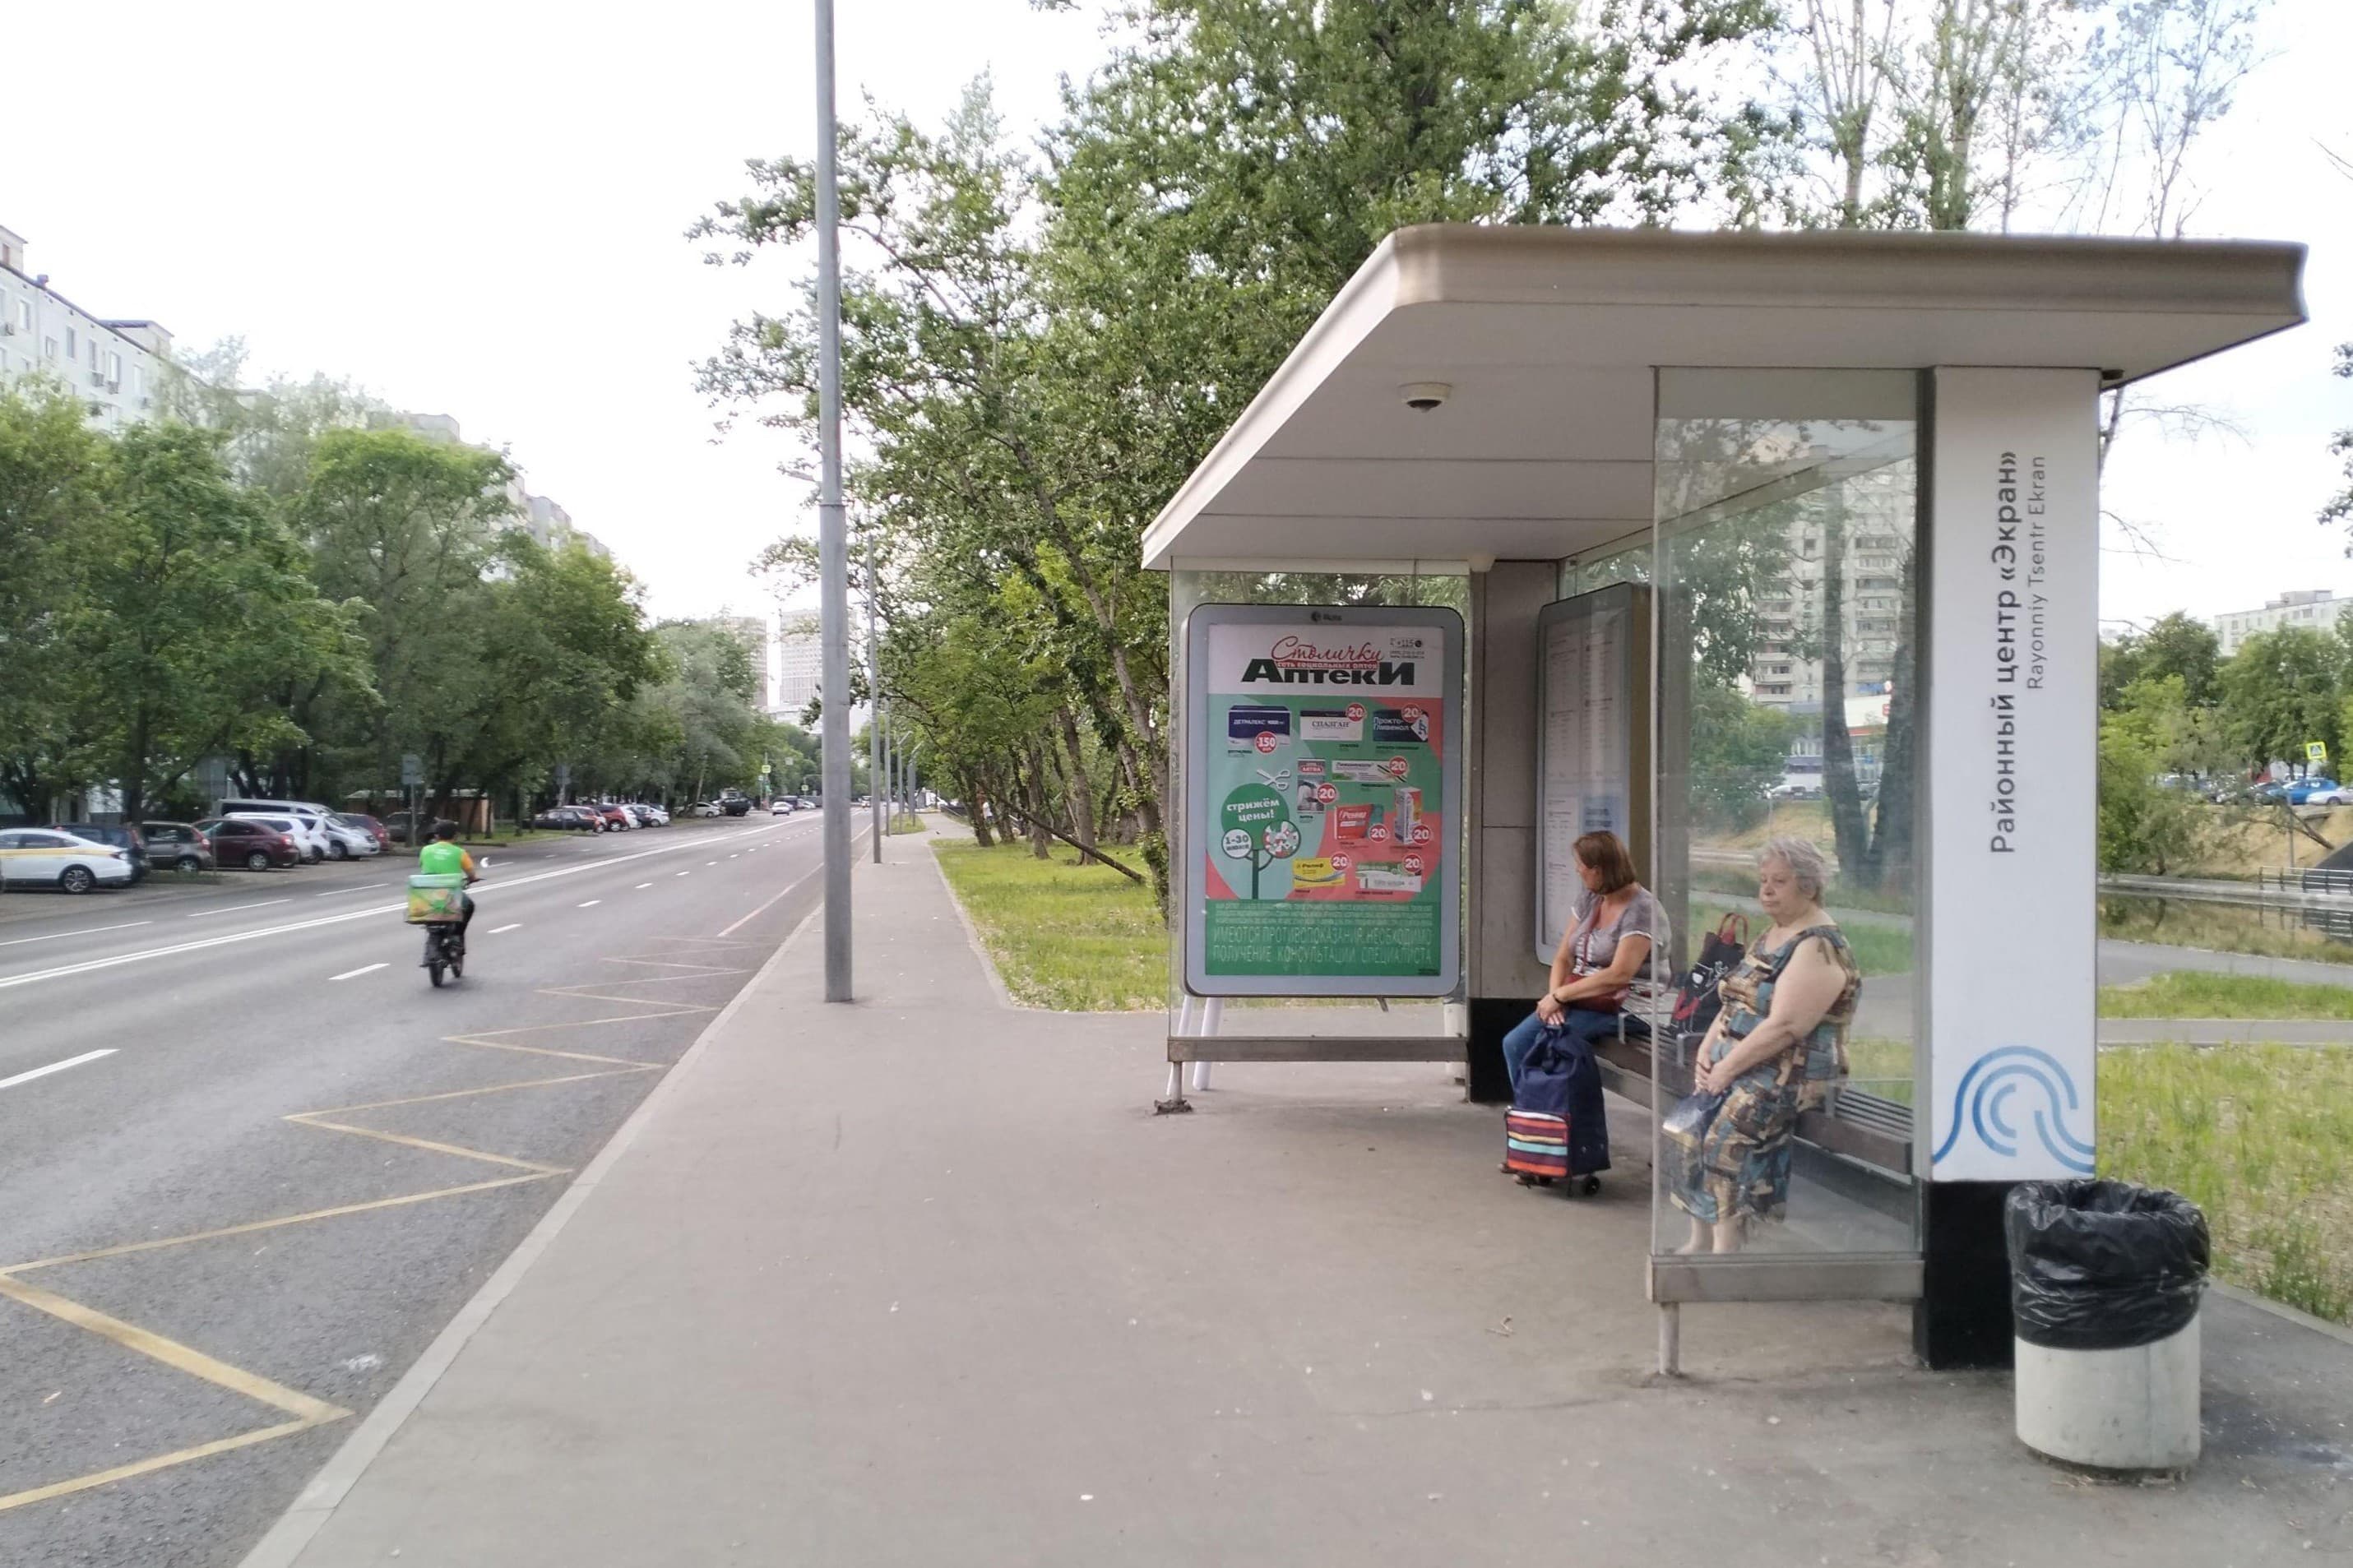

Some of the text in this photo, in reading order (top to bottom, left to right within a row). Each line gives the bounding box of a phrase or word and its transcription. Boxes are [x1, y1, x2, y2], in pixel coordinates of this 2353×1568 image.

[2026, 456, 2049, 689] Rayonniy Tsentr Ekran
[1271, 636, 1383, 661] Столички
[1990, 451, 2022, 852] Районный центр «Экран»
[1226, 798, 1280, 812] стрижём
[1238, 809, 1275, 822] цены!
